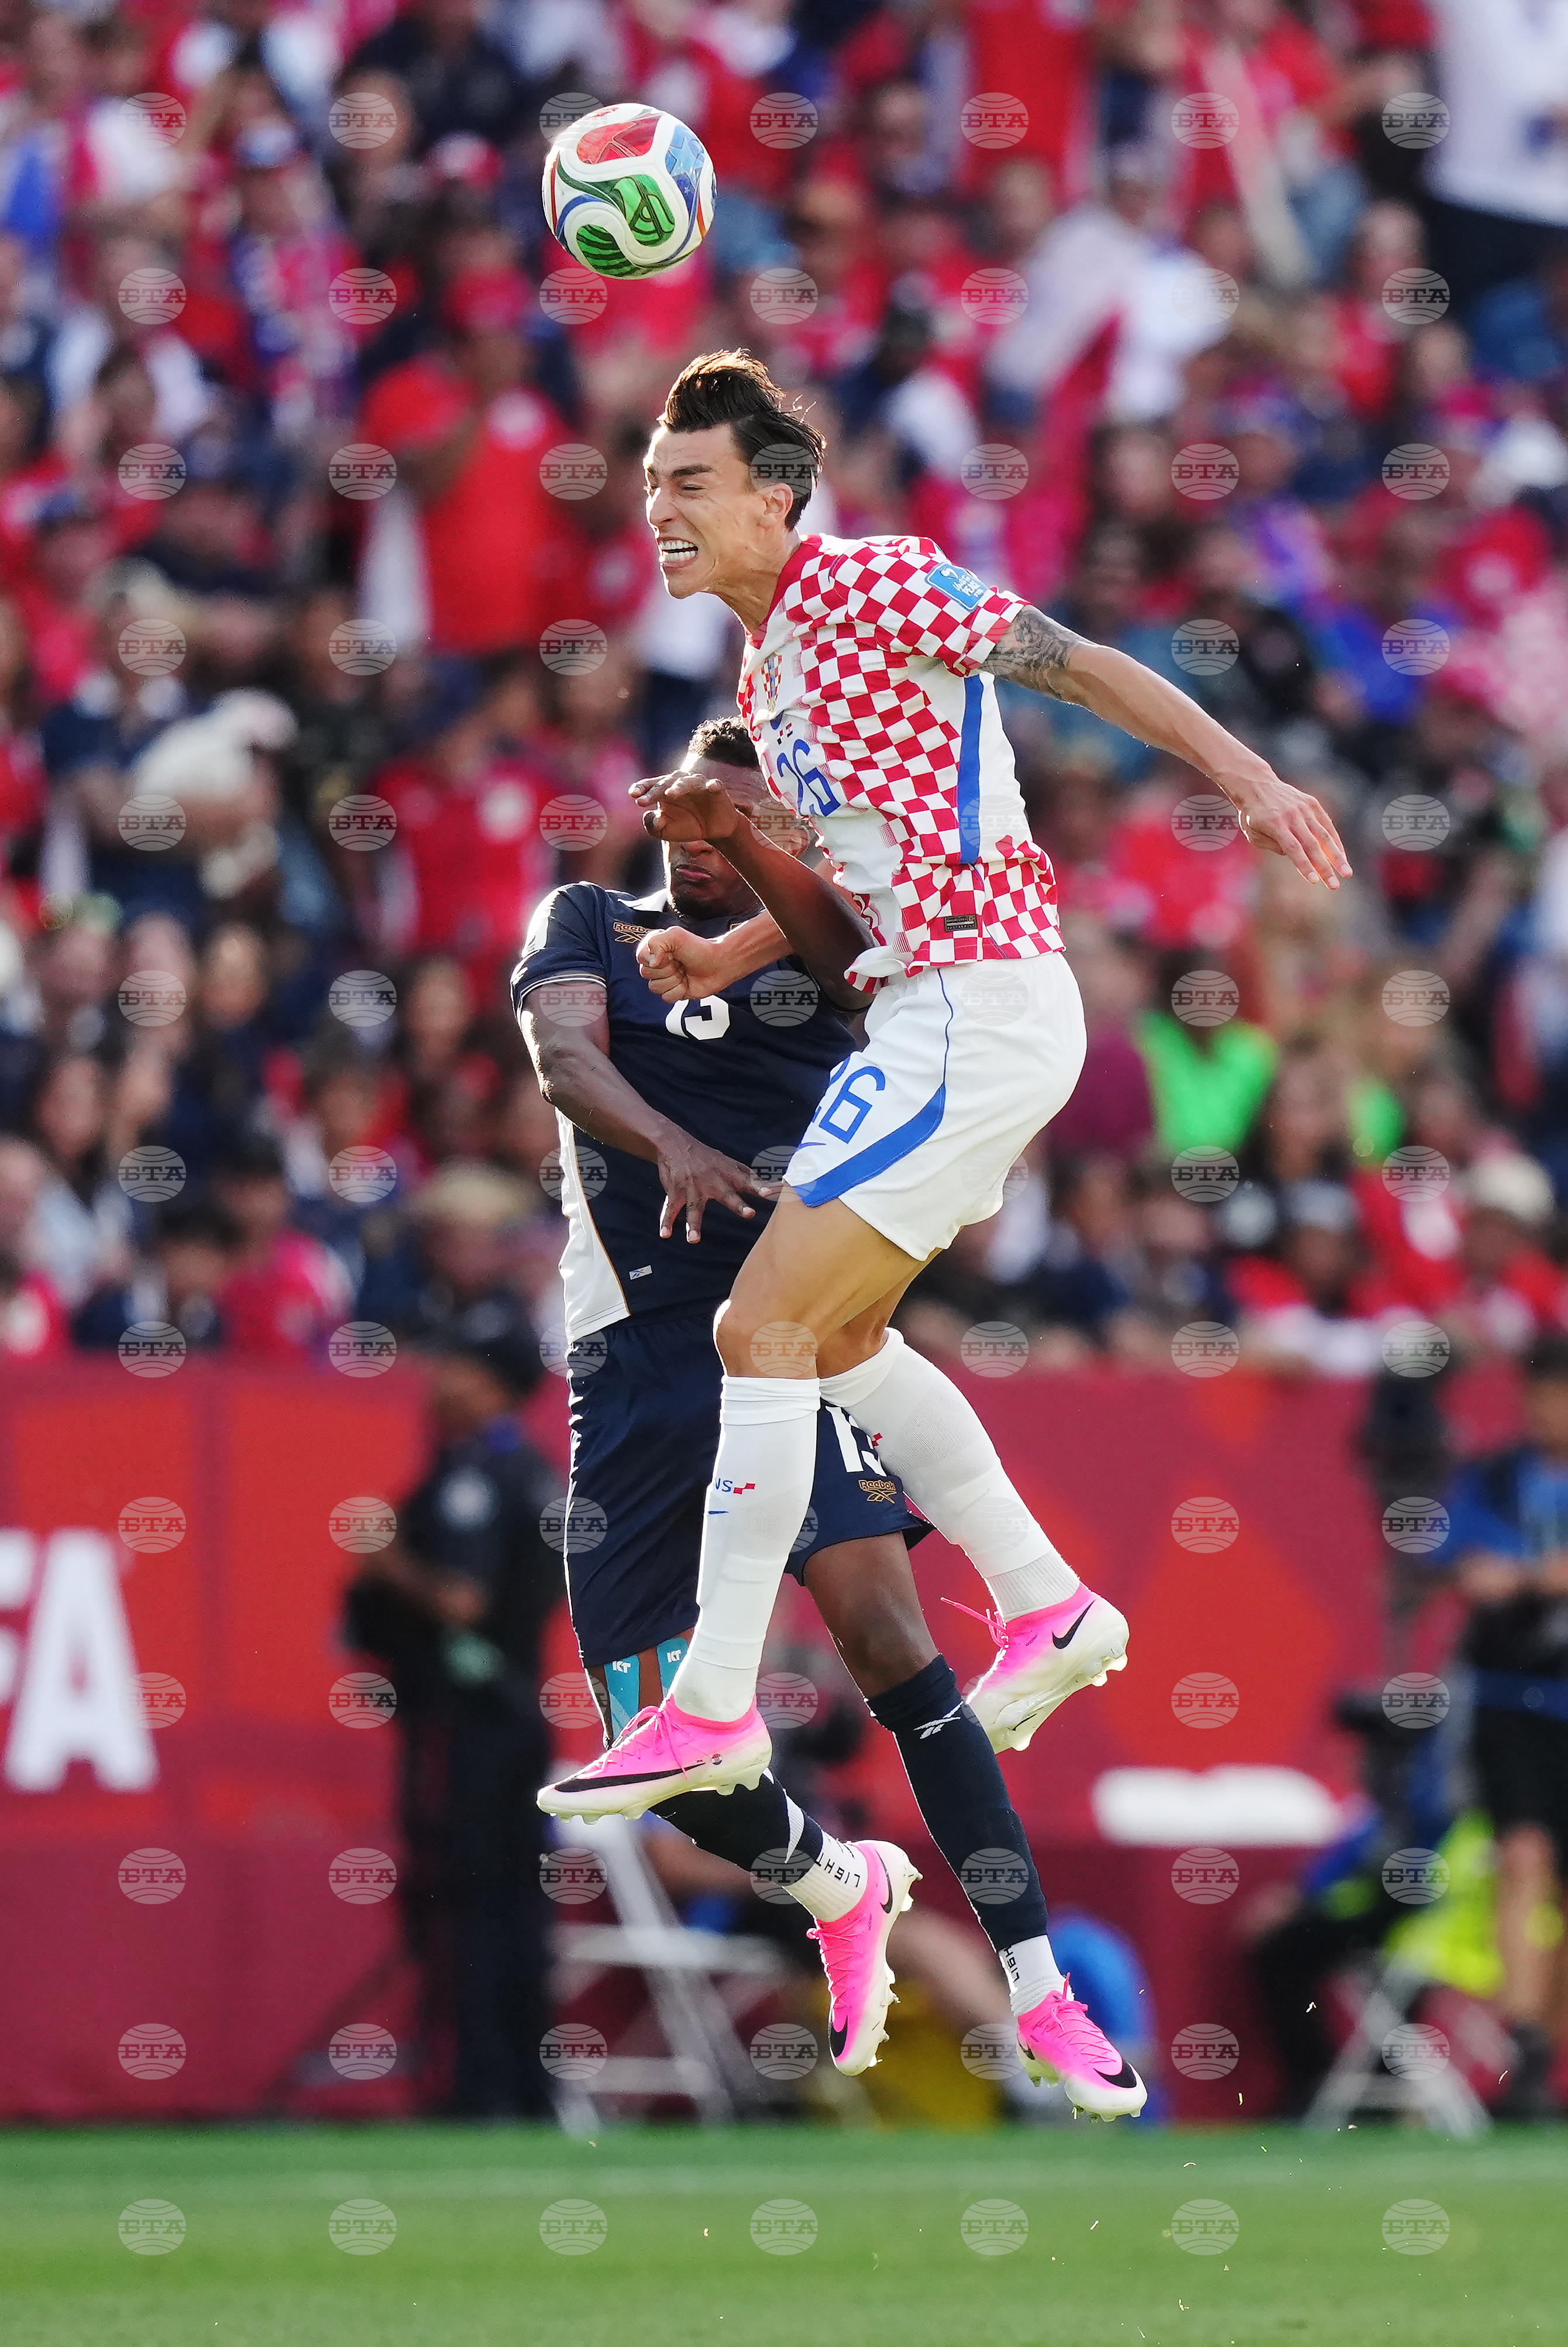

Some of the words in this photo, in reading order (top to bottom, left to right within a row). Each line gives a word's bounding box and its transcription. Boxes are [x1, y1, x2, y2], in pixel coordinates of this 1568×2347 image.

[777, 739, 841, 817] 26
[613, 922, 653, 933] Reeb
[858, 1480, 896, 1490] Reebok
[666, 1650, 682, 1663] KT
[613, 1661, 631, 1674] KT
[816, 1852, 861, 1888] LIGHT
[1003, 1947, 1020, 1982] LIGH
